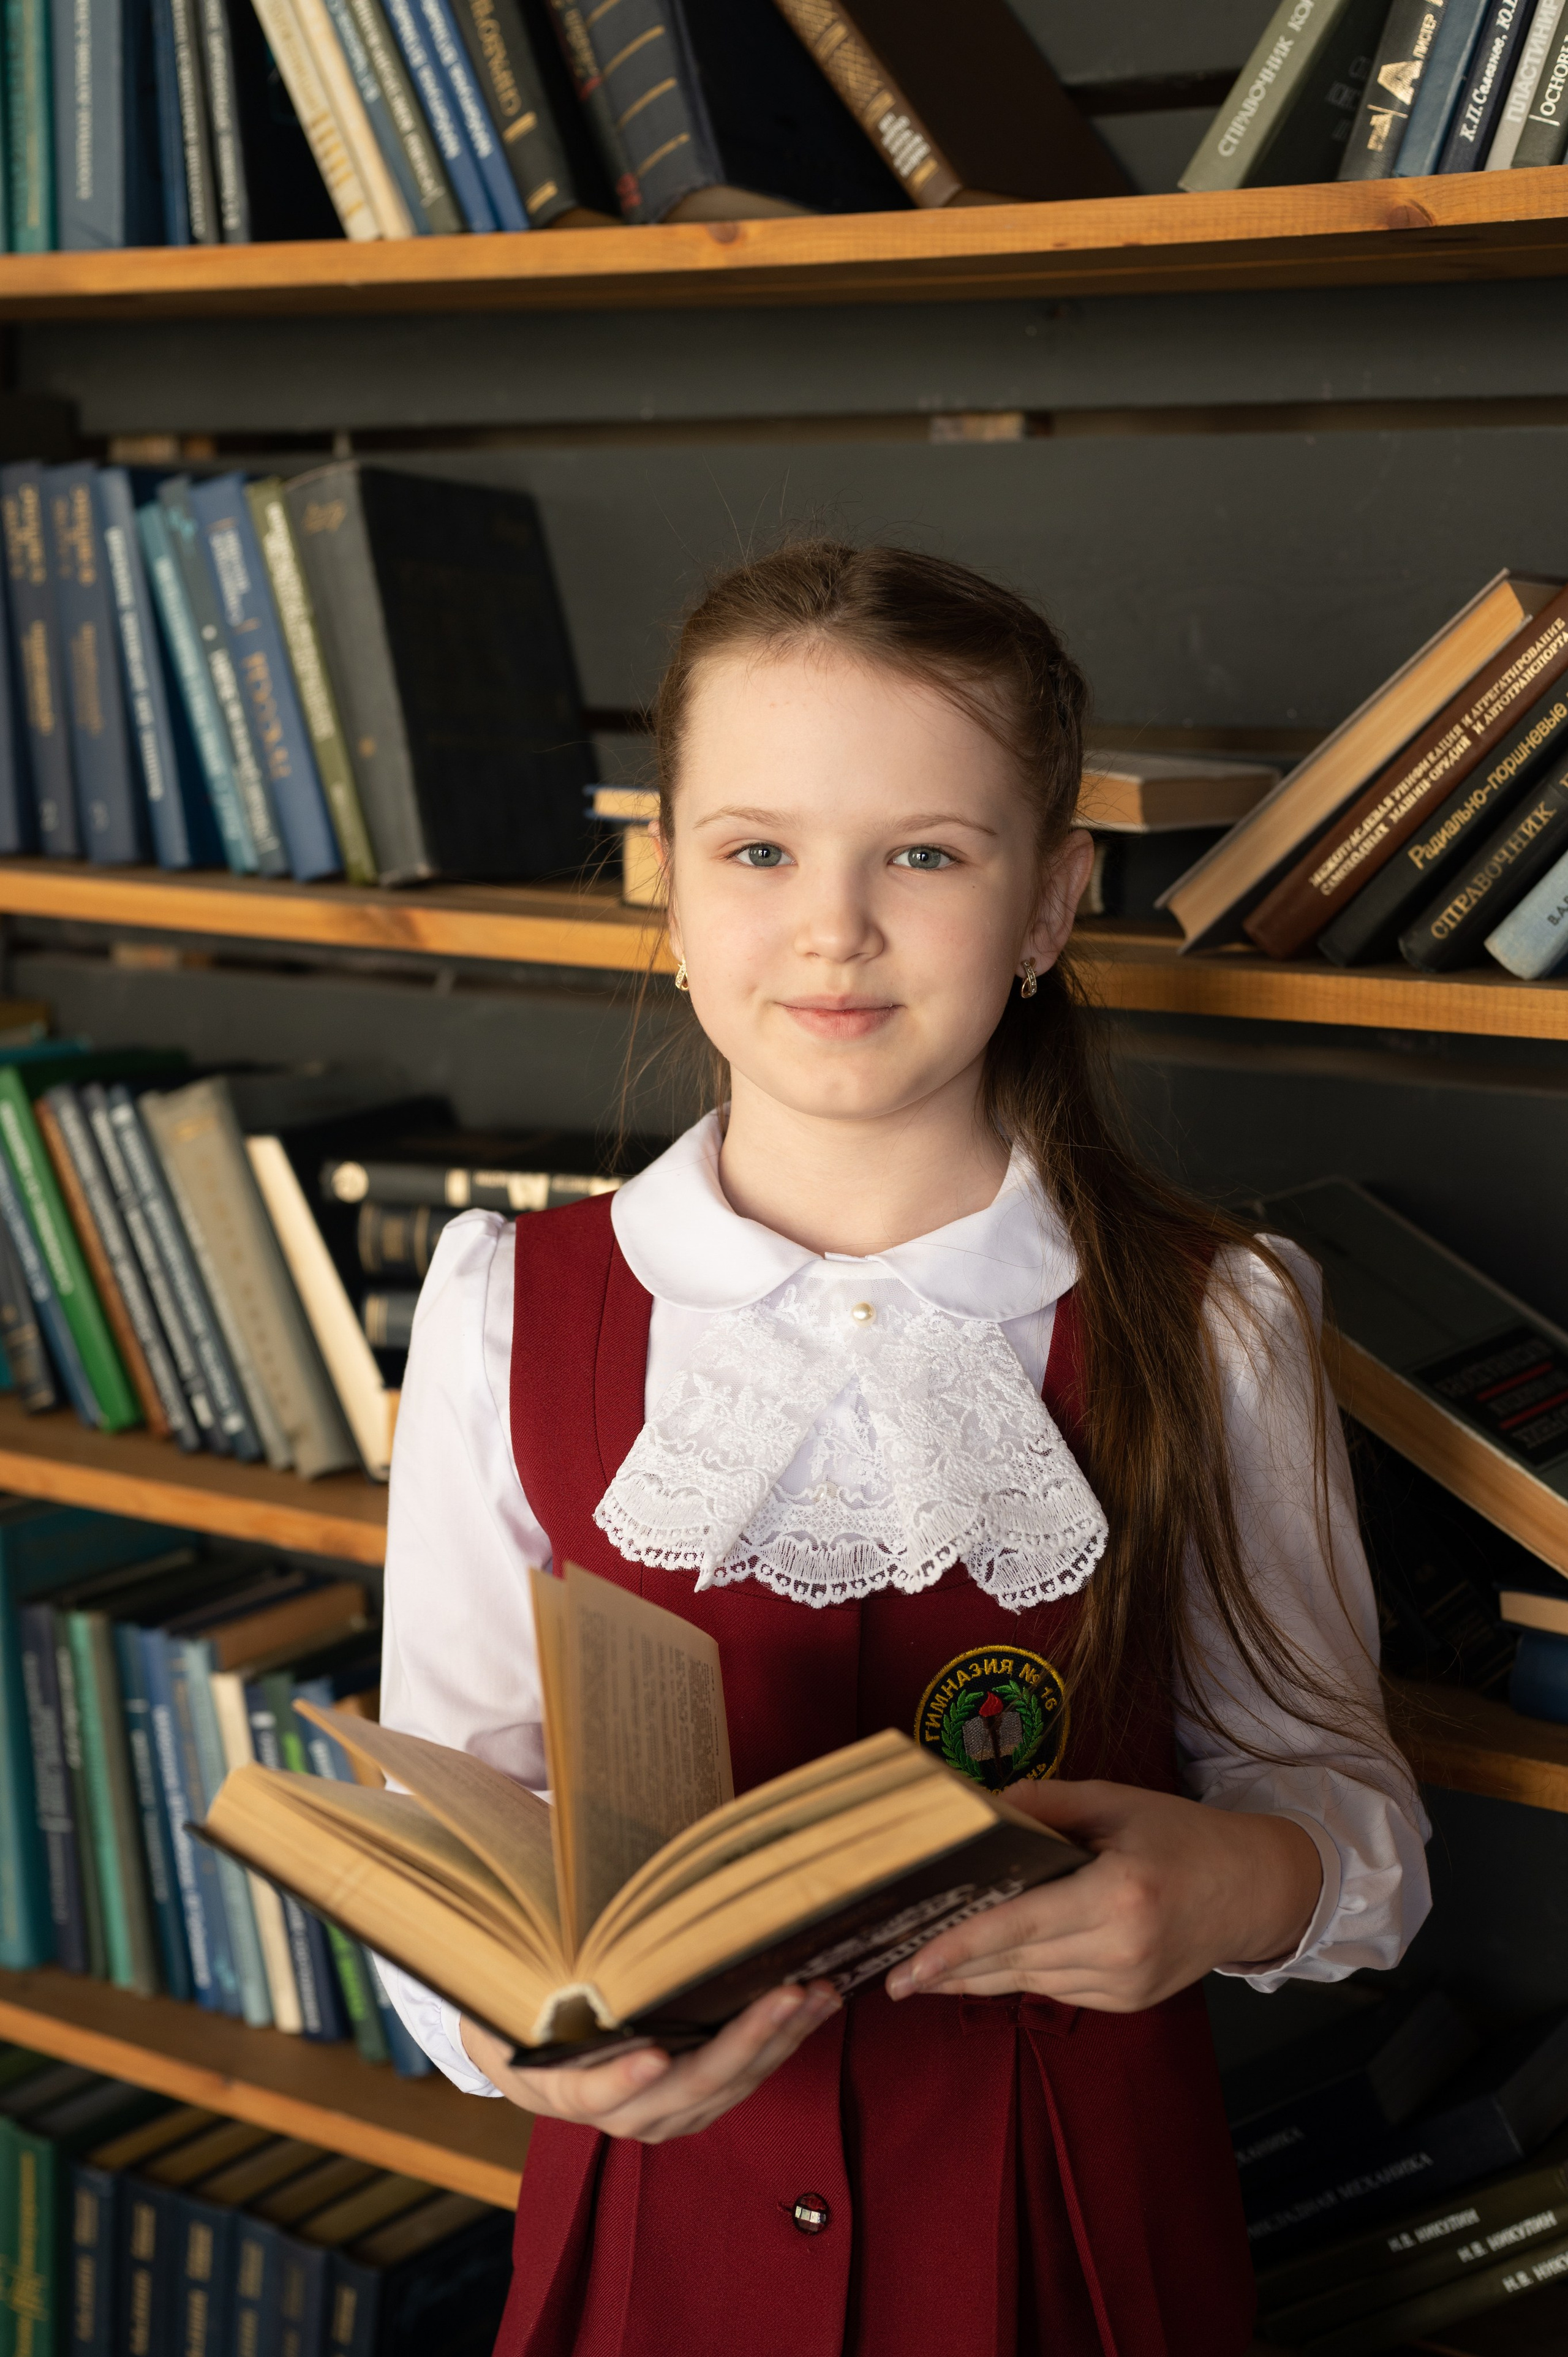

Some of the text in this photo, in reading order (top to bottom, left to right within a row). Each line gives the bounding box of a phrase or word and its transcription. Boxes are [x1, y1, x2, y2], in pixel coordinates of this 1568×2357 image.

[1216, 34, 1295, 157] СПРАВОЧНИК
[1310, 617, 1567, 888] МЕЖОТРАСЛЕВАЯ УНИФИКАЦИЯ И АГРЕГАТИРОВАНИЕ
[1319, 823, 1390, 896] САМОХОДНЫХ
[1471, 720, 1486, 735] И
[1408, 702, 1567, 870] Радиально-поршневые
[1430, 801, 1557, 940] СПРАВОЧНИК
[925, 1658, 1014, 1741] ГИМНАЗИЯ
